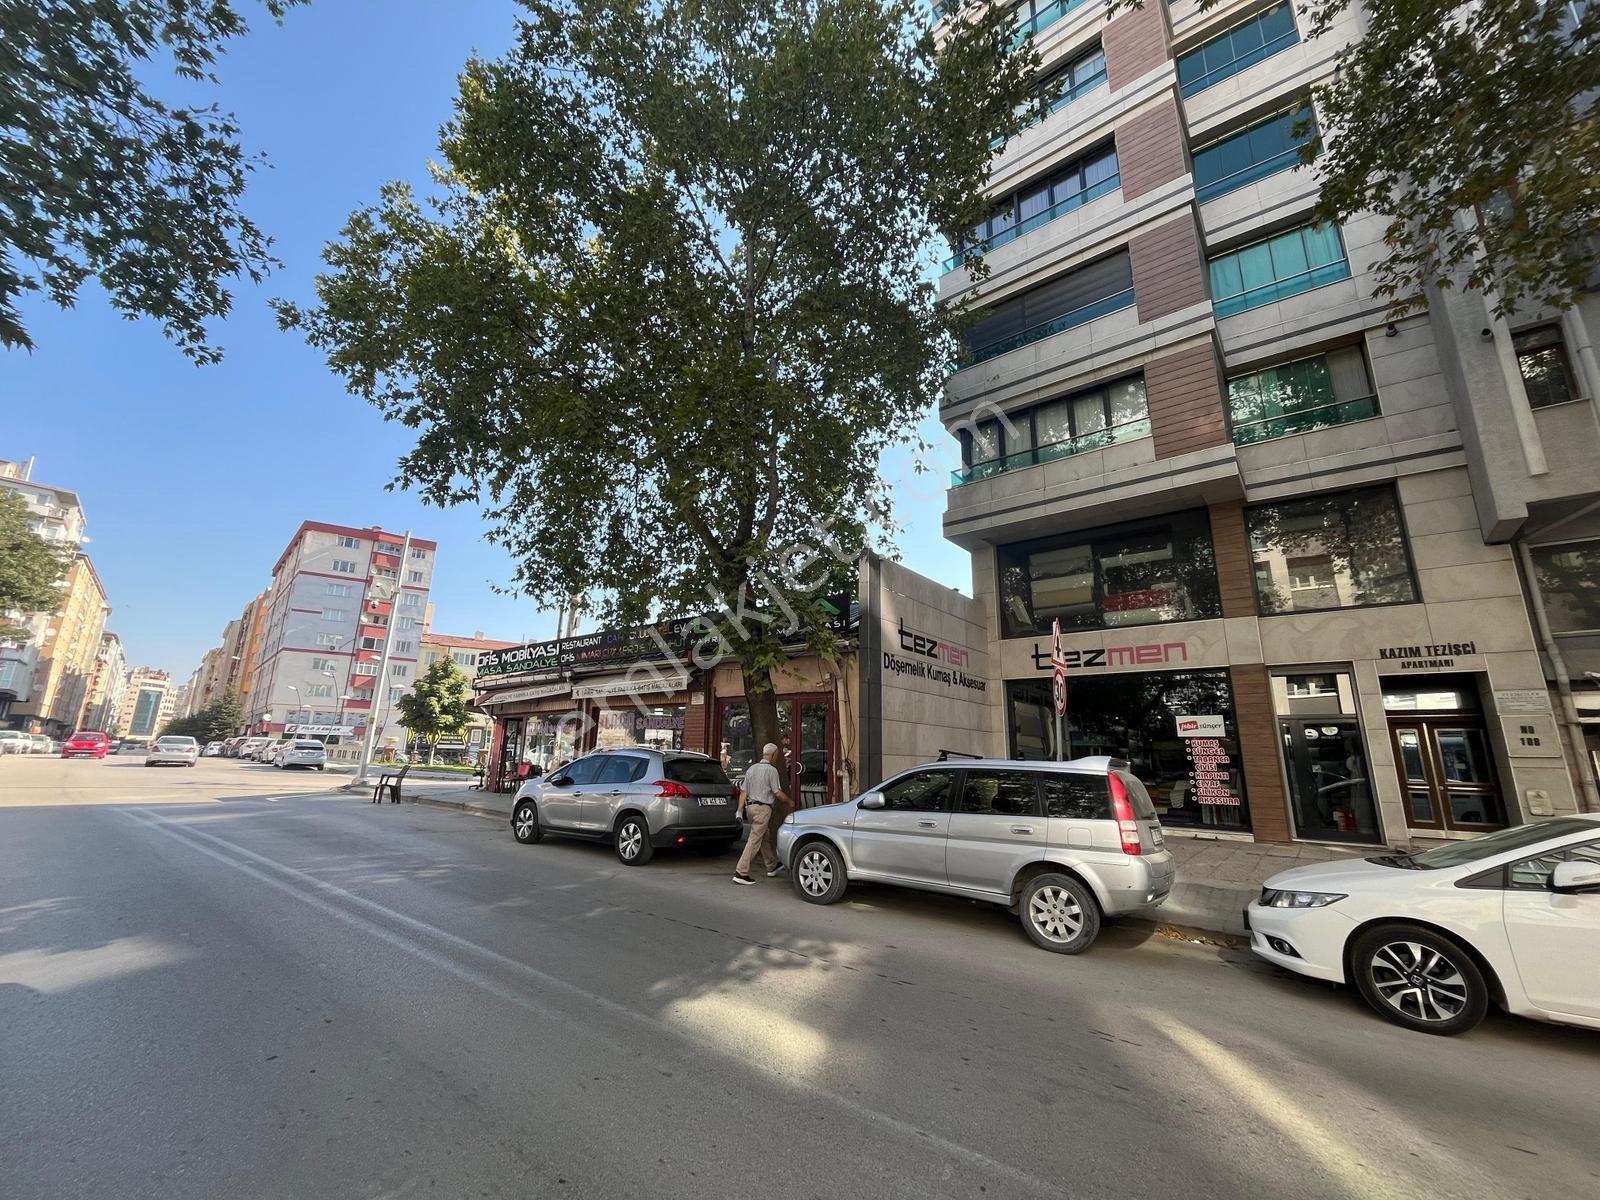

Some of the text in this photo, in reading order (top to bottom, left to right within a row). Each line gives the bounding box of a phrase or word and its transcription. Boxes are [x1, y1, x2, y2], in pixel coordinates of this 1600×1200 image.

[561, 636, 603, 651] RESTAURANT
[898, 617, 968, 668] tezmen
[501, 643, 560, 663] MOBİLYASI
[1031, 642, 1188, 670] tezmen
[1379, 646, 1421, 659] KAZIM
[476, 657, 559, 676] MASA SANDALYE
[1401, 659, 1454, 669] APARTMANI
[883, 652, 986, 692] Döşemelik Kumaş & Aksesuar
[1054, 680, 1064, 706] 30
[1520, 726, 1535, 734] NO
[1191, 740, 1219, 749] KUMAŞ
[1196, 780, 1220, 788] ELYAF
[1198, 797, 1240, 805] AKSESUAR
